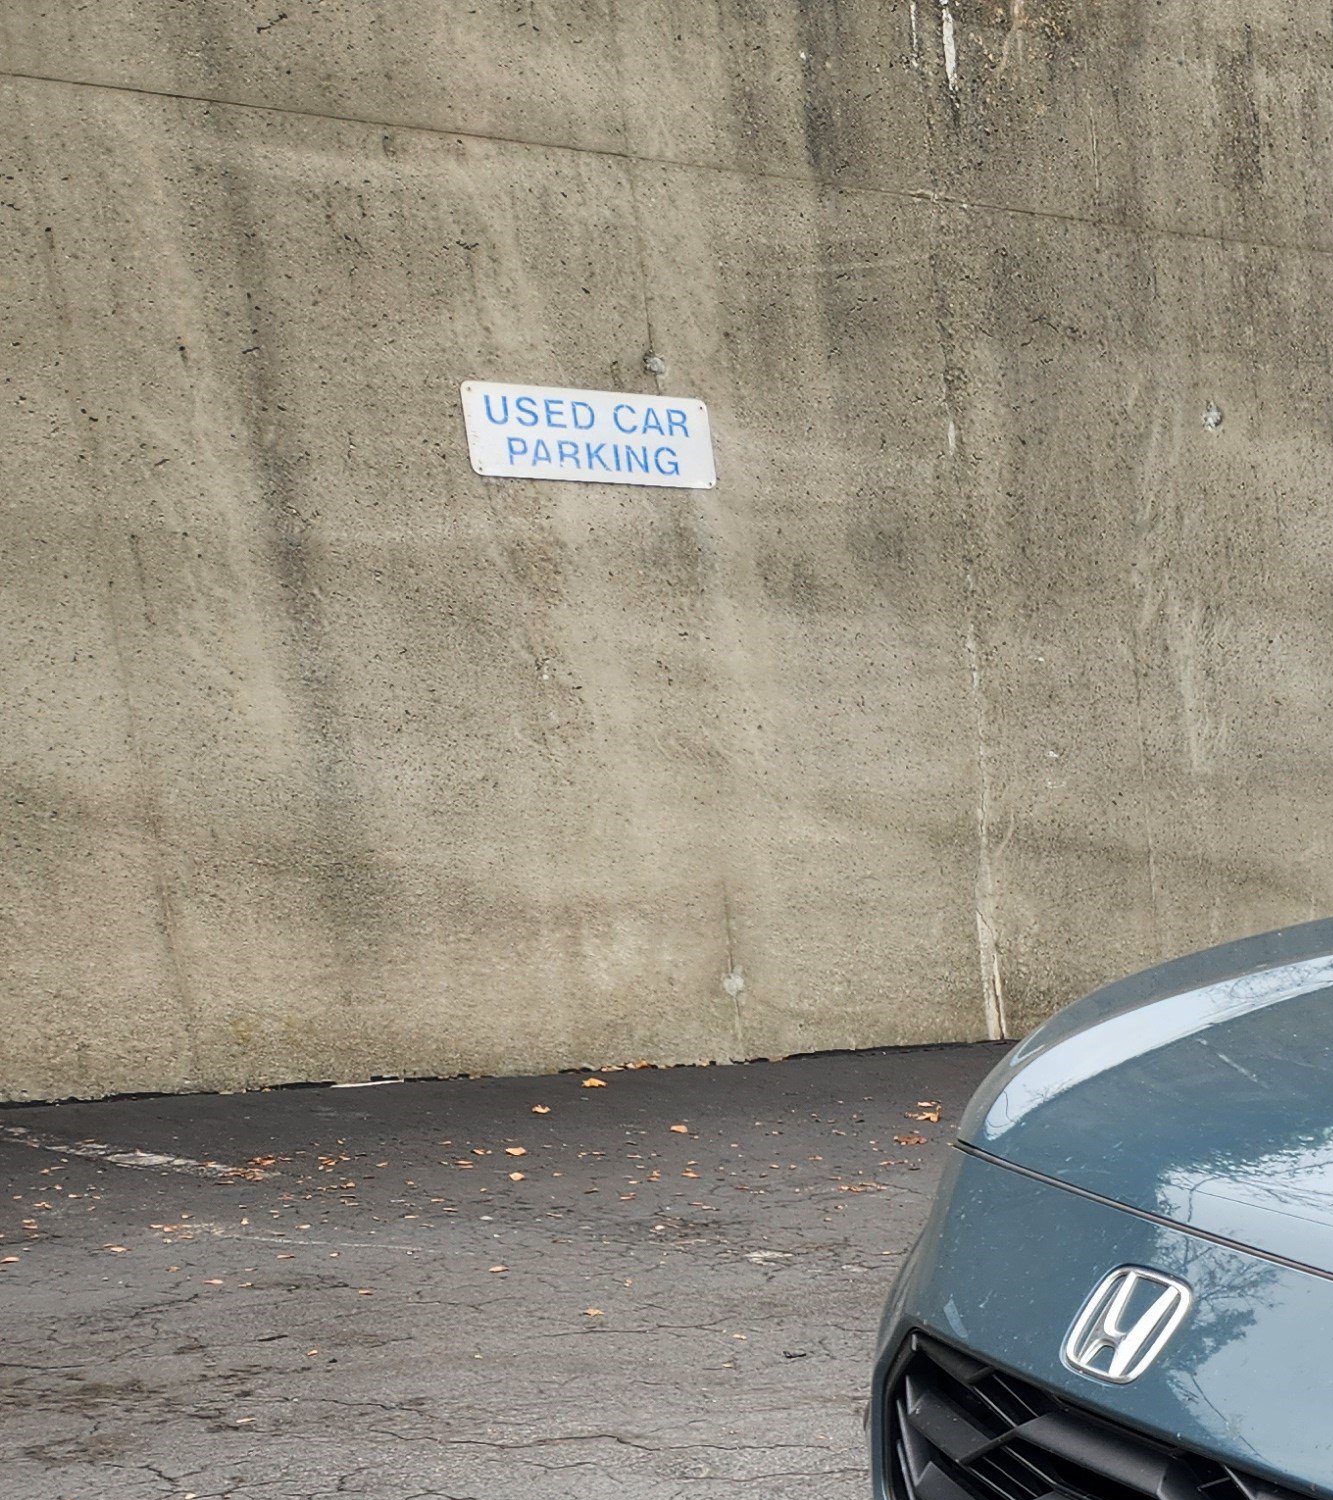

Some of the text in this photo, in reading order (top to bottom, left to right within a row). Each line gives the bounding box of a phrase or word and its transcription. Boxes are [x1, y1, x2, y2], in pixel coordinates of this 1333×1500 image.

[483, 394, 690, 438] USED CAR
[506, 436, 681, 477] PARKING
